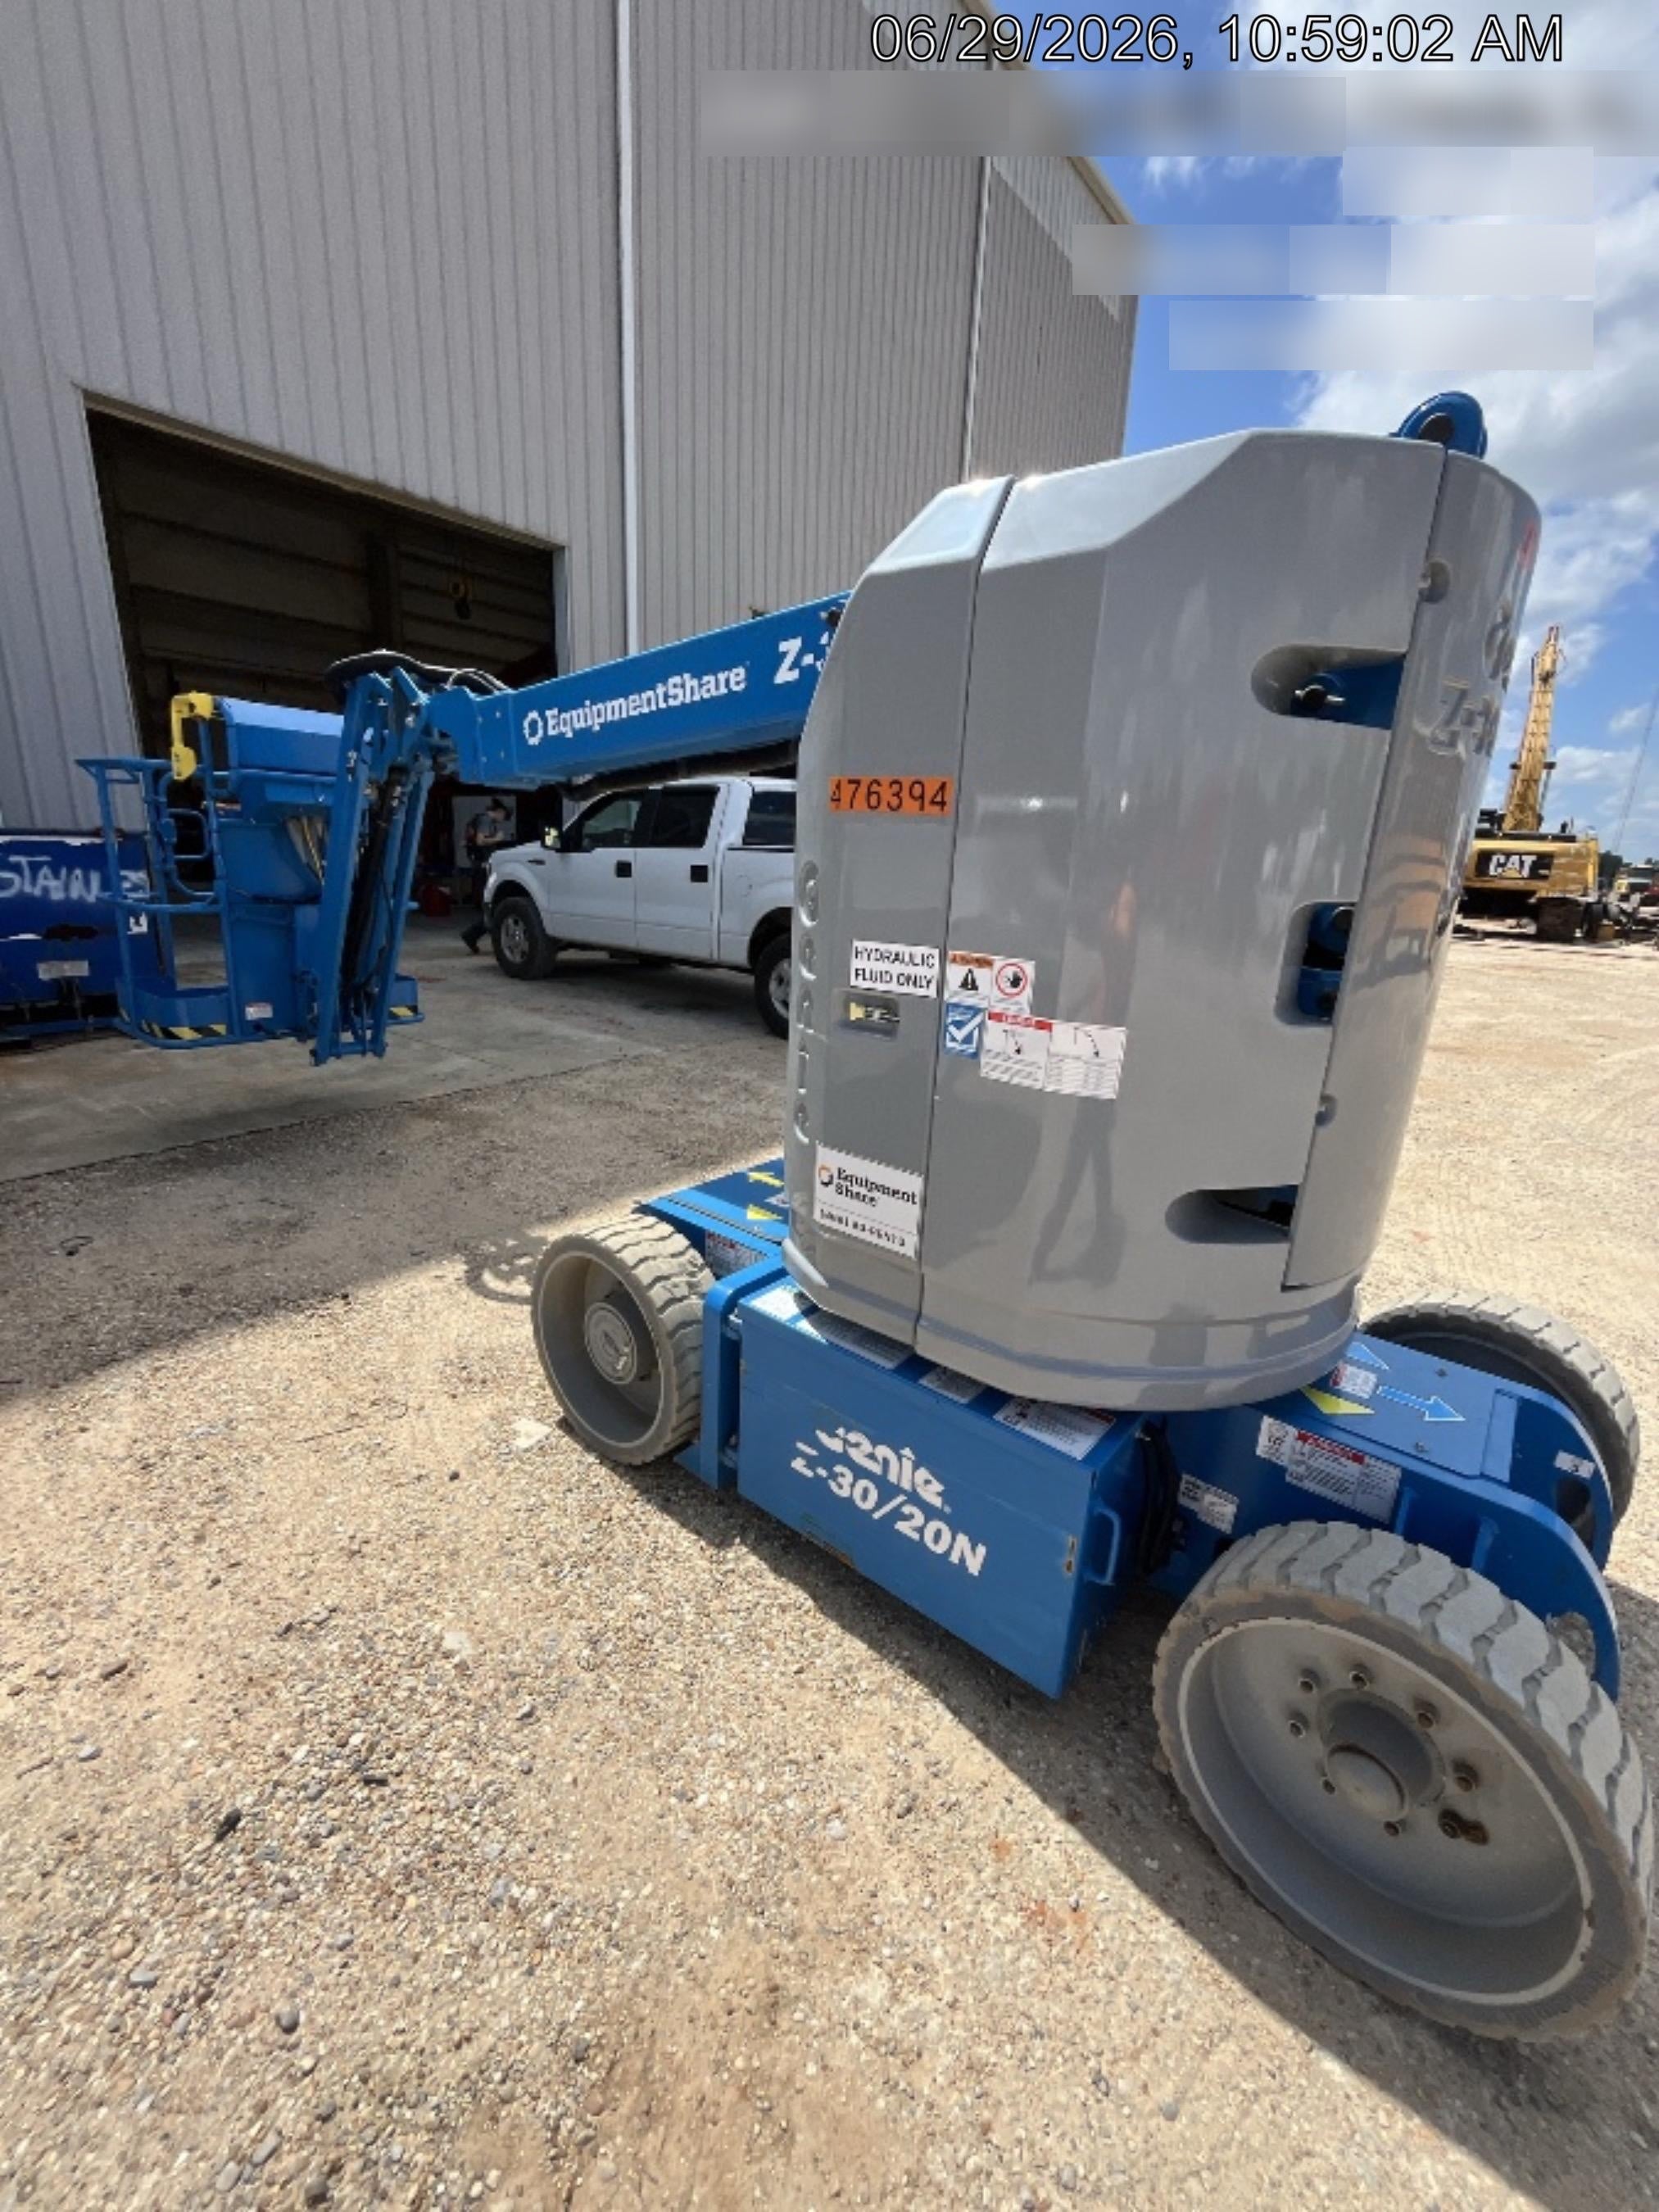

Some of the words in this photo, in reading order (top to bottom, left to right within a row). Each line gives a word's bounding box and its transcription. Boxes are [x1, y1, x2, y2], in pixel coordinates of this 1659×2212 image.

[546, 664, 746, 737] EquipmentShare
[831, 779, 947, 812] 476394
[1489, 854, 1537, 878] CAT
[854, 946, 935, 968] HYDRAULIC
[855, 968, 893, 983] FLUID
[897, 972, 934, 990] ONLY
[836, 1181, 877, 1207] Share
[837, 1167, 918, 1205] Equipment
